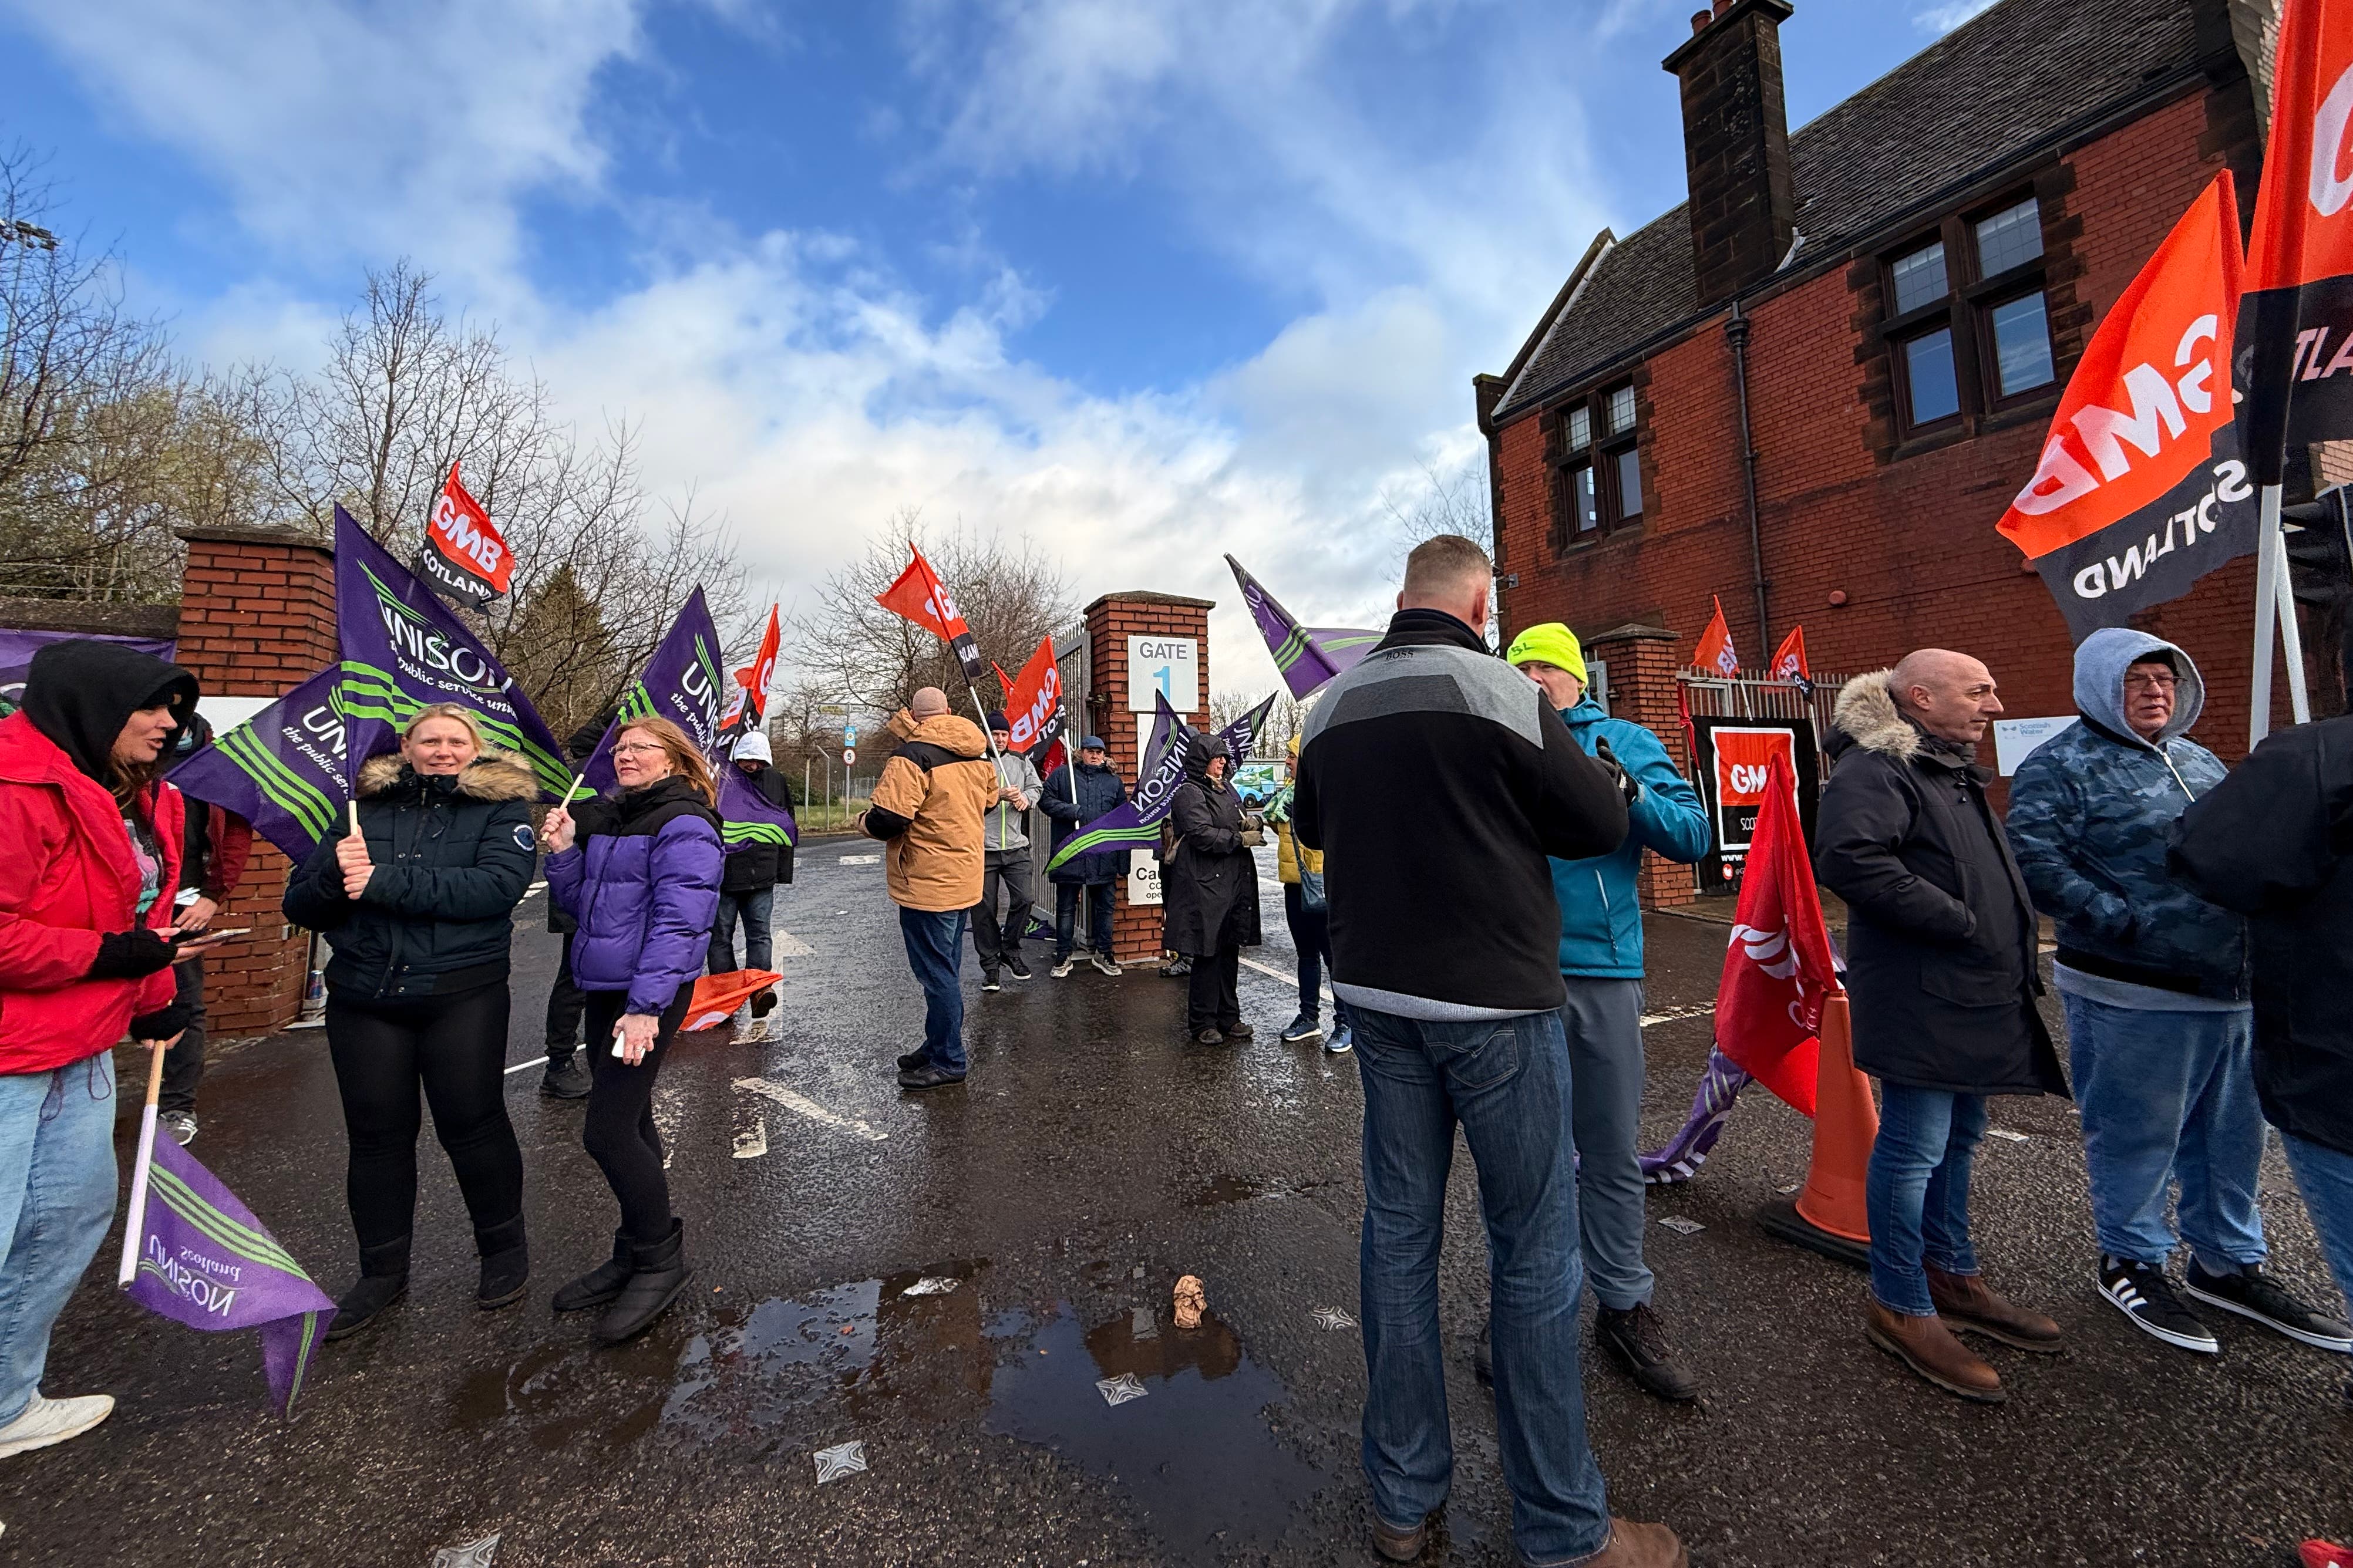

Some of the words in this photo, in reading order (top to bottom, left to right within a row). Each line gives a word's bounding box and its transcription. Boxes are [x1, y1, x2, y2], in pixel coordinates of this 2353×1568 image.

[432, 495, 503, 573] GMB
[1140, 642, 1187, 659] GATE
[1153, 666, 1170, 703] 1
[303, 706, 348, 761] UN
[671, 693, 689, 713] the
[686, 711, 706, 748] public
[282, 727, 304, 743] the
[296, 743, 336, 774] public
[1731, 764, 1770, 794] GM
